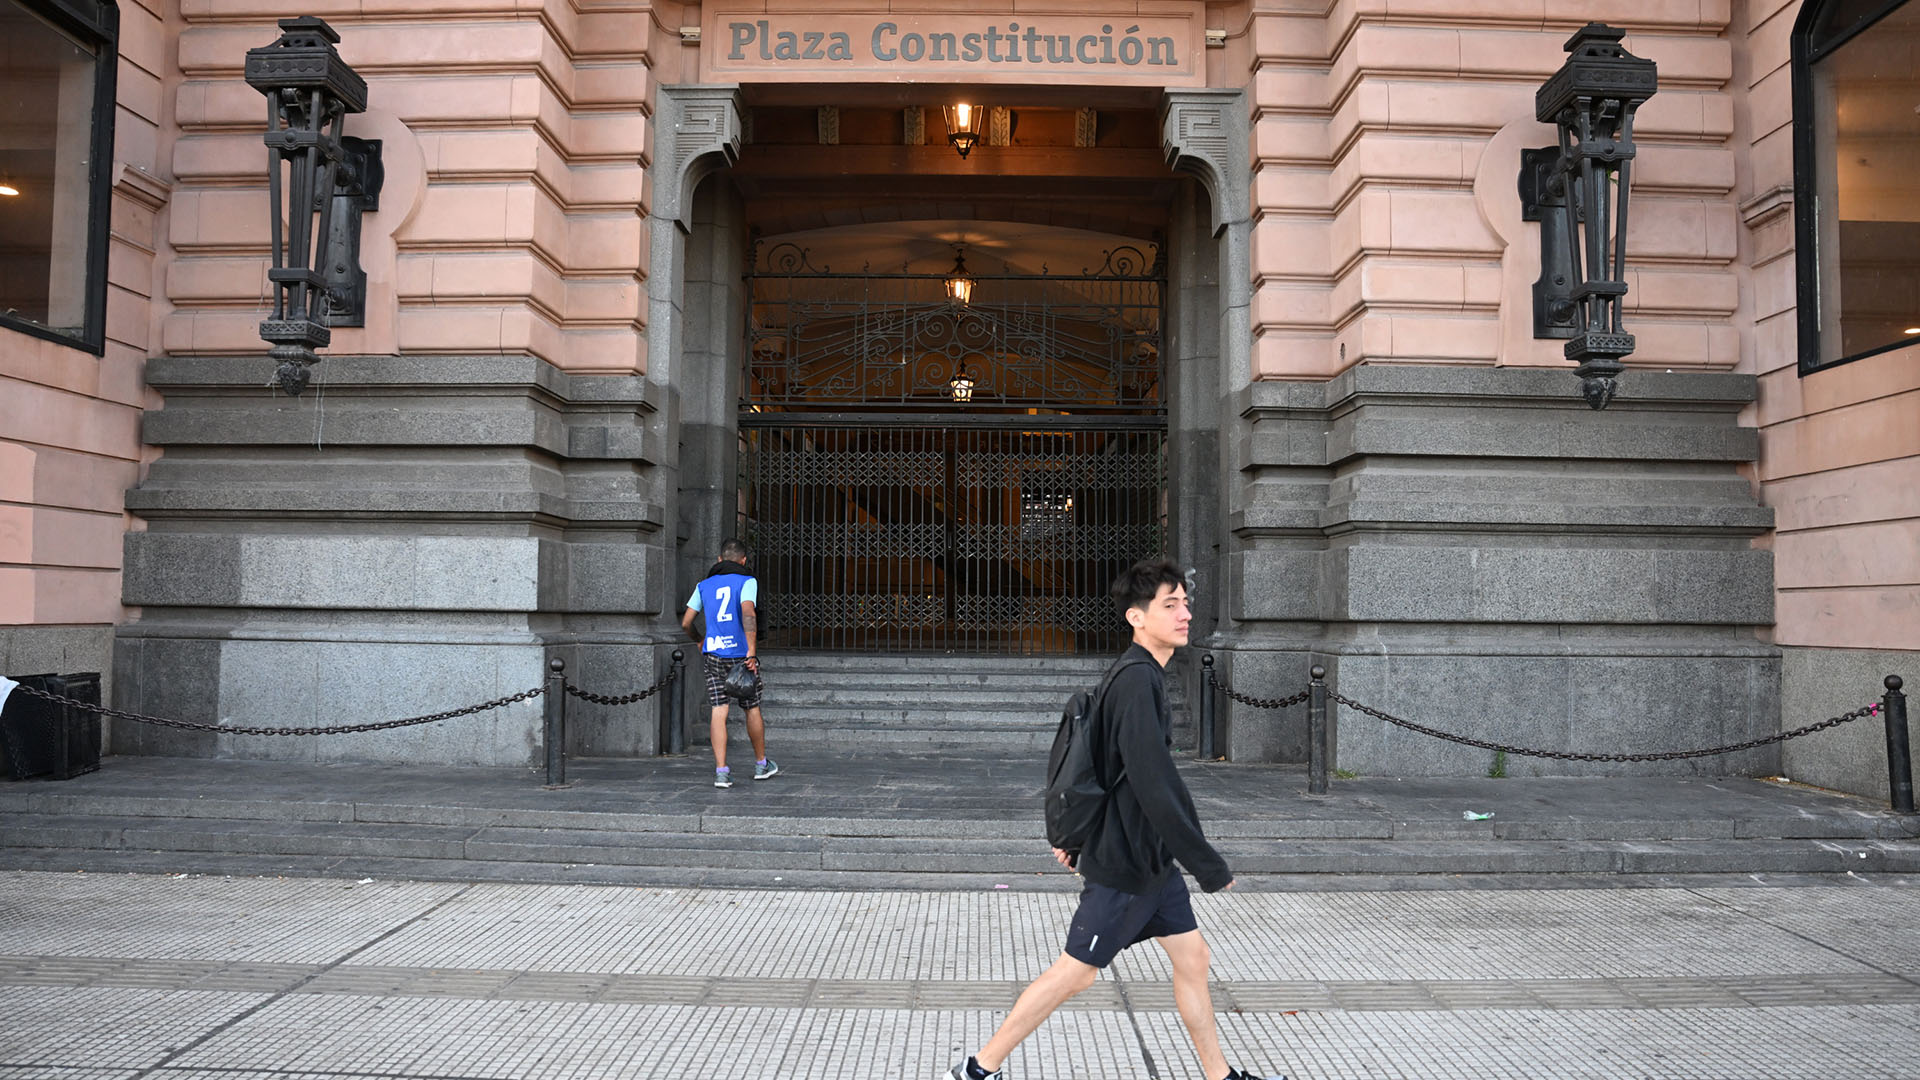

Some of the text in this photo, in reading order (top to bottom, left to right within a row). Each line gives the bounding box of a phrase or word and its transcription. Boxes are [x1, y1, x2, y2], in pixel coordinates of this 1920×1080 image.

[728, 21, 1178, 66] Plaza Constitución
[716, 586, 733, 622] 2
